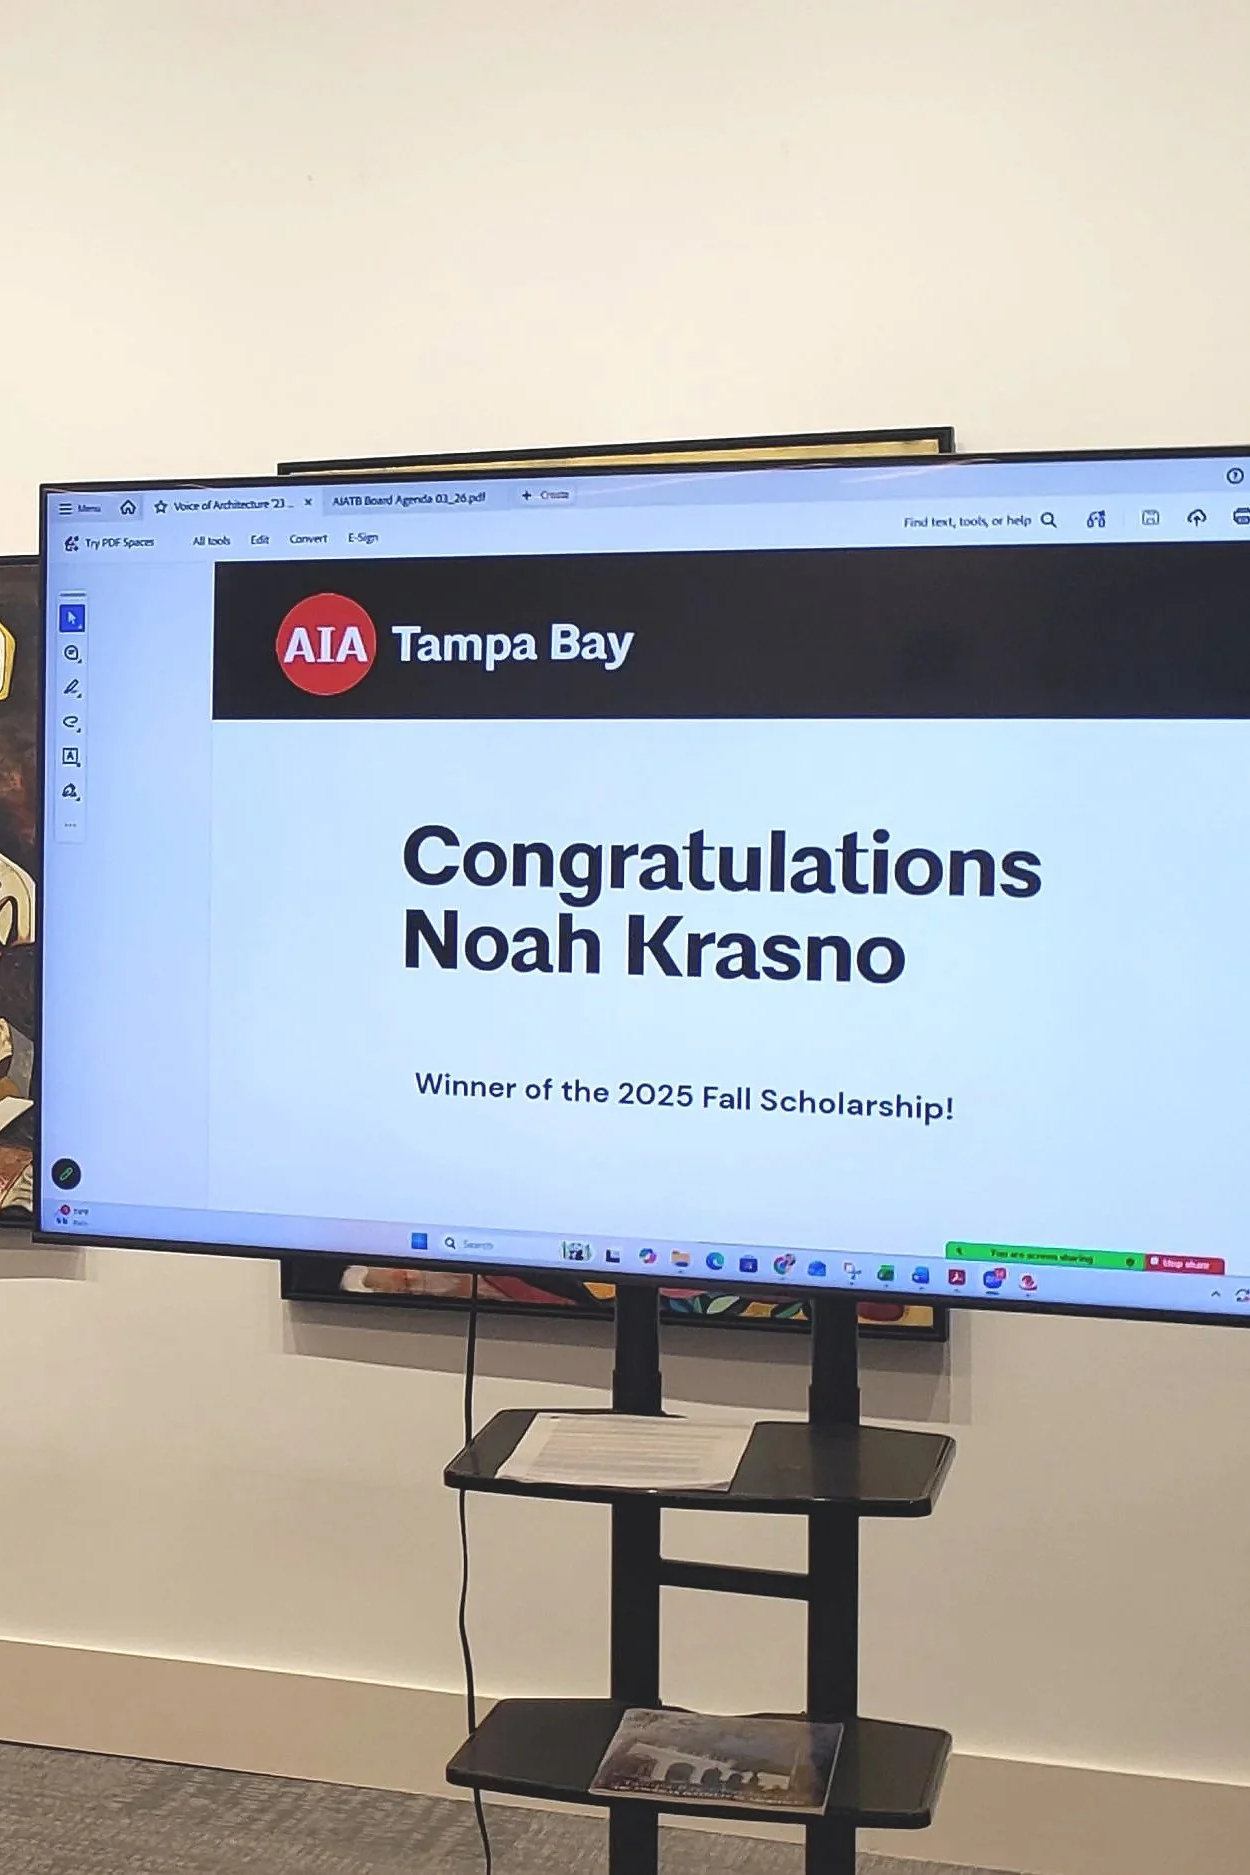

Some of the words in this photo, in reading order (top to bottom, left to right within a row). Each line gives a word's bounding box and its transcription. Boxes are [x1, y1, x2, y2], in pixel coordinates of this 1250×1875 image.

[174, 502, 200, 511] Voice
[202, 500, 211, 510] of
[214, 499, 269, 509] Architecture
[365, 494, 393, 505] Board
[395, 494, 433, 507] Agenda
[904, 517, 928, 528] Find
[931, 517, 956, 529] text,
[992, 517, 1003, 526] or
[1007, 515, 1032, 527] help
[86, 539, 100, 549] Try
[102, 538, 120, 547] PDF
[124, 538, 154, 548] Spaces
[193, 536, 205, 546] All
[208, 536, 231, 546] tools
[251, 535, 269, 545] Edit
[290, 534, 327, 544] Convert
[348, 533, 379, 544] E-Sign
[284, 626, 368, 664] AIA
[391, 625, 538, 672] Tampa
[551, 623, 635, 671] Bay
[403, 824, 1042, 908] Congratulations
[404, 908, 601, 975] Noah
[627, 913, 906, 984] Krasno
[415, 1072, 517, 1099] Winner
[525, 1078, 553, 1101] of
[561, 1079, 610, 1103] the
[618, 1082, 694, 1107] 2025
[703, 1086, 751, 1111] Fall
[760, 1089, 953, 1126] Scholarship!
